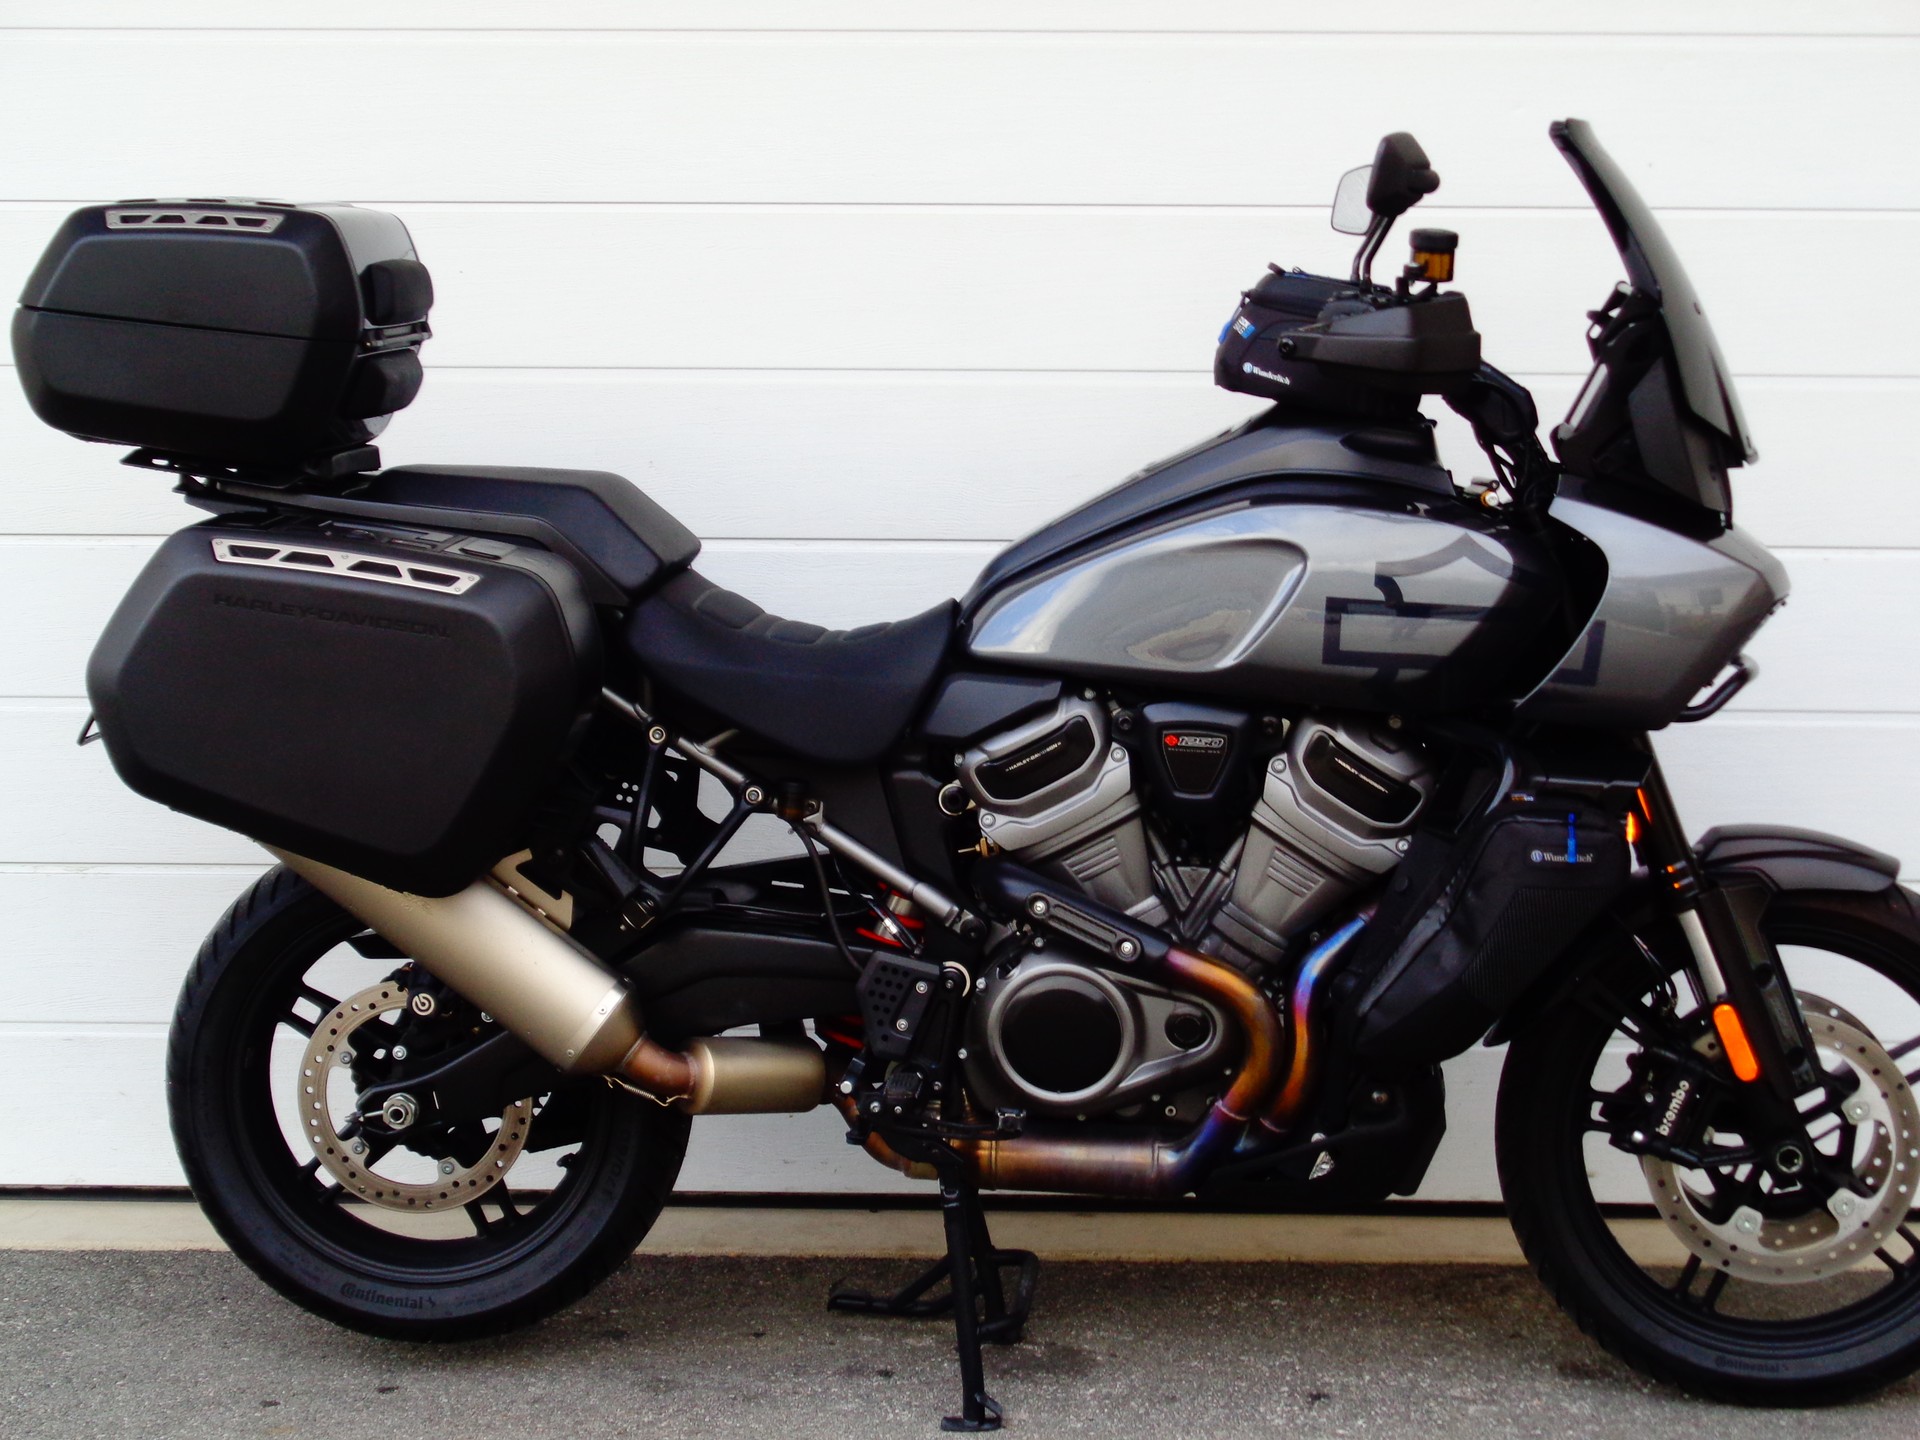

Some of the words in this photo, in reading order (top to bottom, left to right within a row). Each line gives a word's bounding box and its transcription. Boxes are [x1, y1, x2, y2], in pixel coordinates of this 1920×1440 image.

[1253, 365, 1290, 385] Wunderlich
[1655, 1080, 1690, 1136] brembo
[340, 1282, 424, 1309] Continental
[1714, 1354, 1780, 1373] Continental
